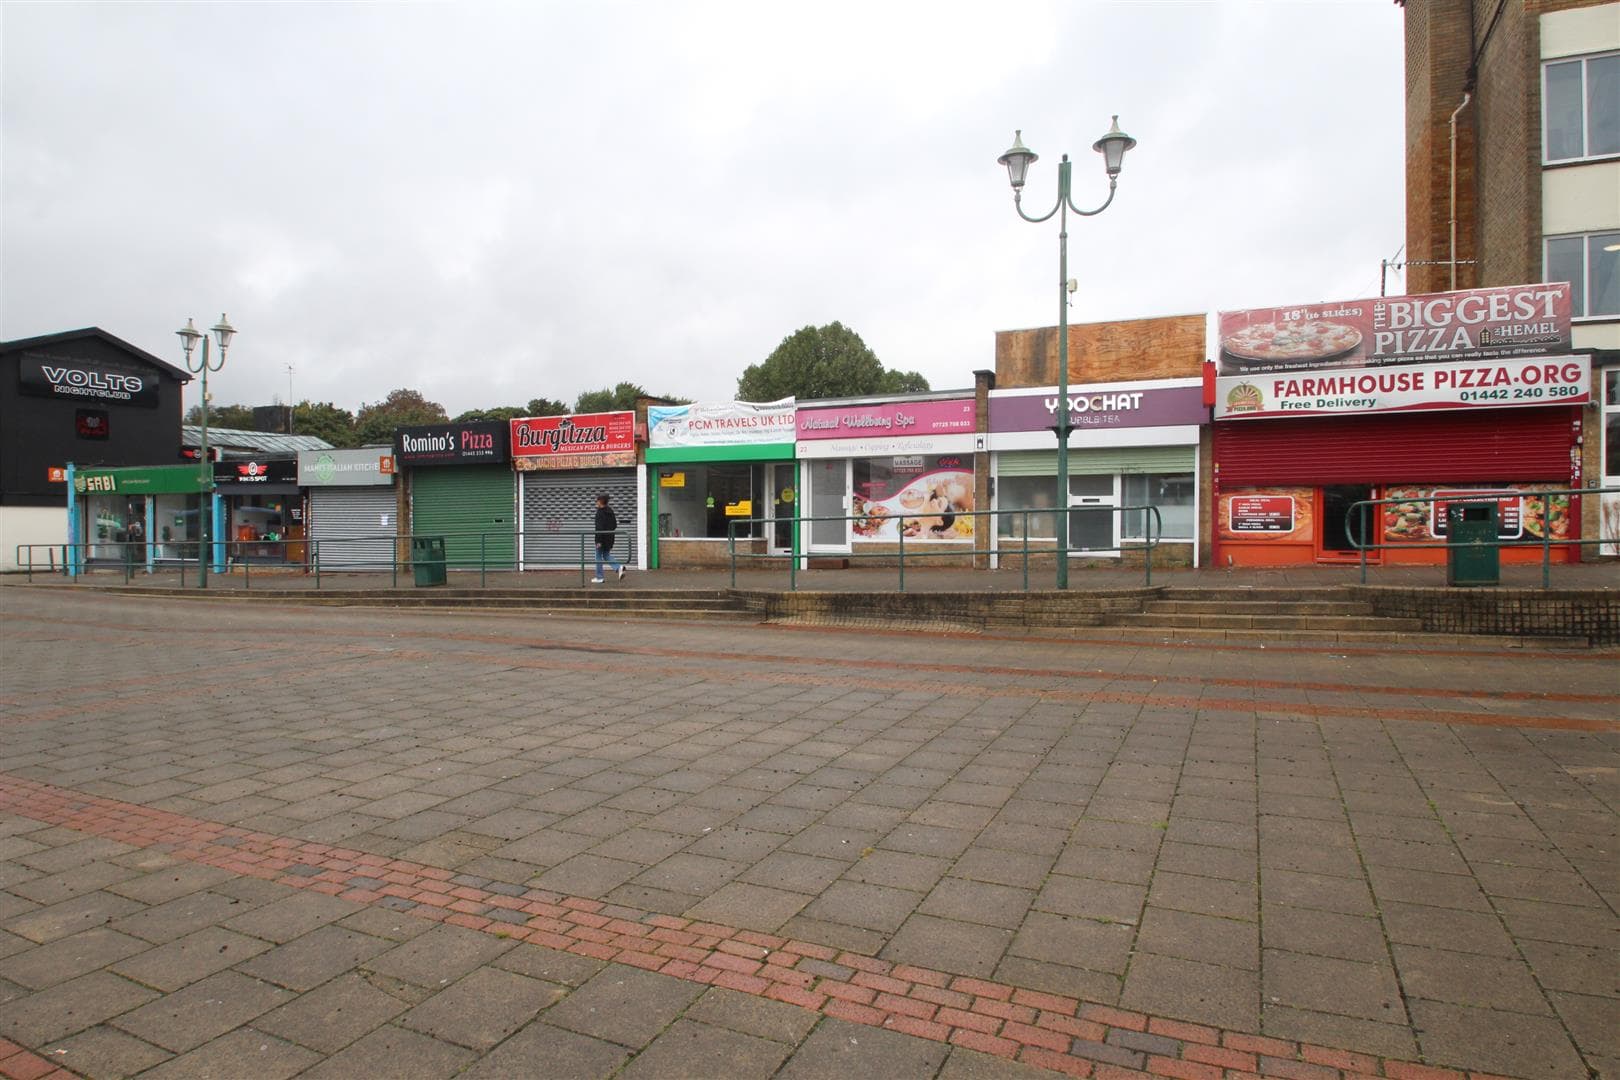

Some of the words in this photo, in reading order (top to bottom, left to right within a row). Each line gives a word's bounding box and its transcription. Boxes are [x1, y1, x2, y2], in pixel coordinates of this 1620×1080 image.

[1373, 302, 1386, 329] THE
[1388, 290, 1562, 330] BIGGEST
[1373, 327, 1475, 355] PIZZA
[1501, 322, 1560, 336] HEMEL
[41, 366, 143, 393] VOLTS
[1274, 372, 1424, 398] FARMHOUSE
[1434, 363, 1582, 389] PIZZA.ORG
[54, 385, 131, 400] NIGHTCLUB
[1460, 390, 1508, 401] 01442
[1513, 387, 1543, 399] 240
[1549, 386, 1579, 397] 580
[1281, 399, 1311, 409] Free
[1316, 398, 1377, 409] Delivery
[688, 420, 713, 430] PCM
[714, 416, 758, 429] TRAVELS
[760, 415, 775, 426] UK
[778, 414, 795, 425] LTD
[800, 416, 840, 430] Natural
[842, 415, 892, 429] Wellbeing
[895, 412, 915, 429] Spa
[402, 431, 455, 452] Romino's
[461, 430, 493, 449] Pizza
[517, 422, 608, 453] Burgitzza
[560, 444, 584, 452] MEXICAN
[584, 443, 600, 451] PIZZA
[353, 462, 379, 472] KITCHE
[86, 475, 117, 491] SABI
